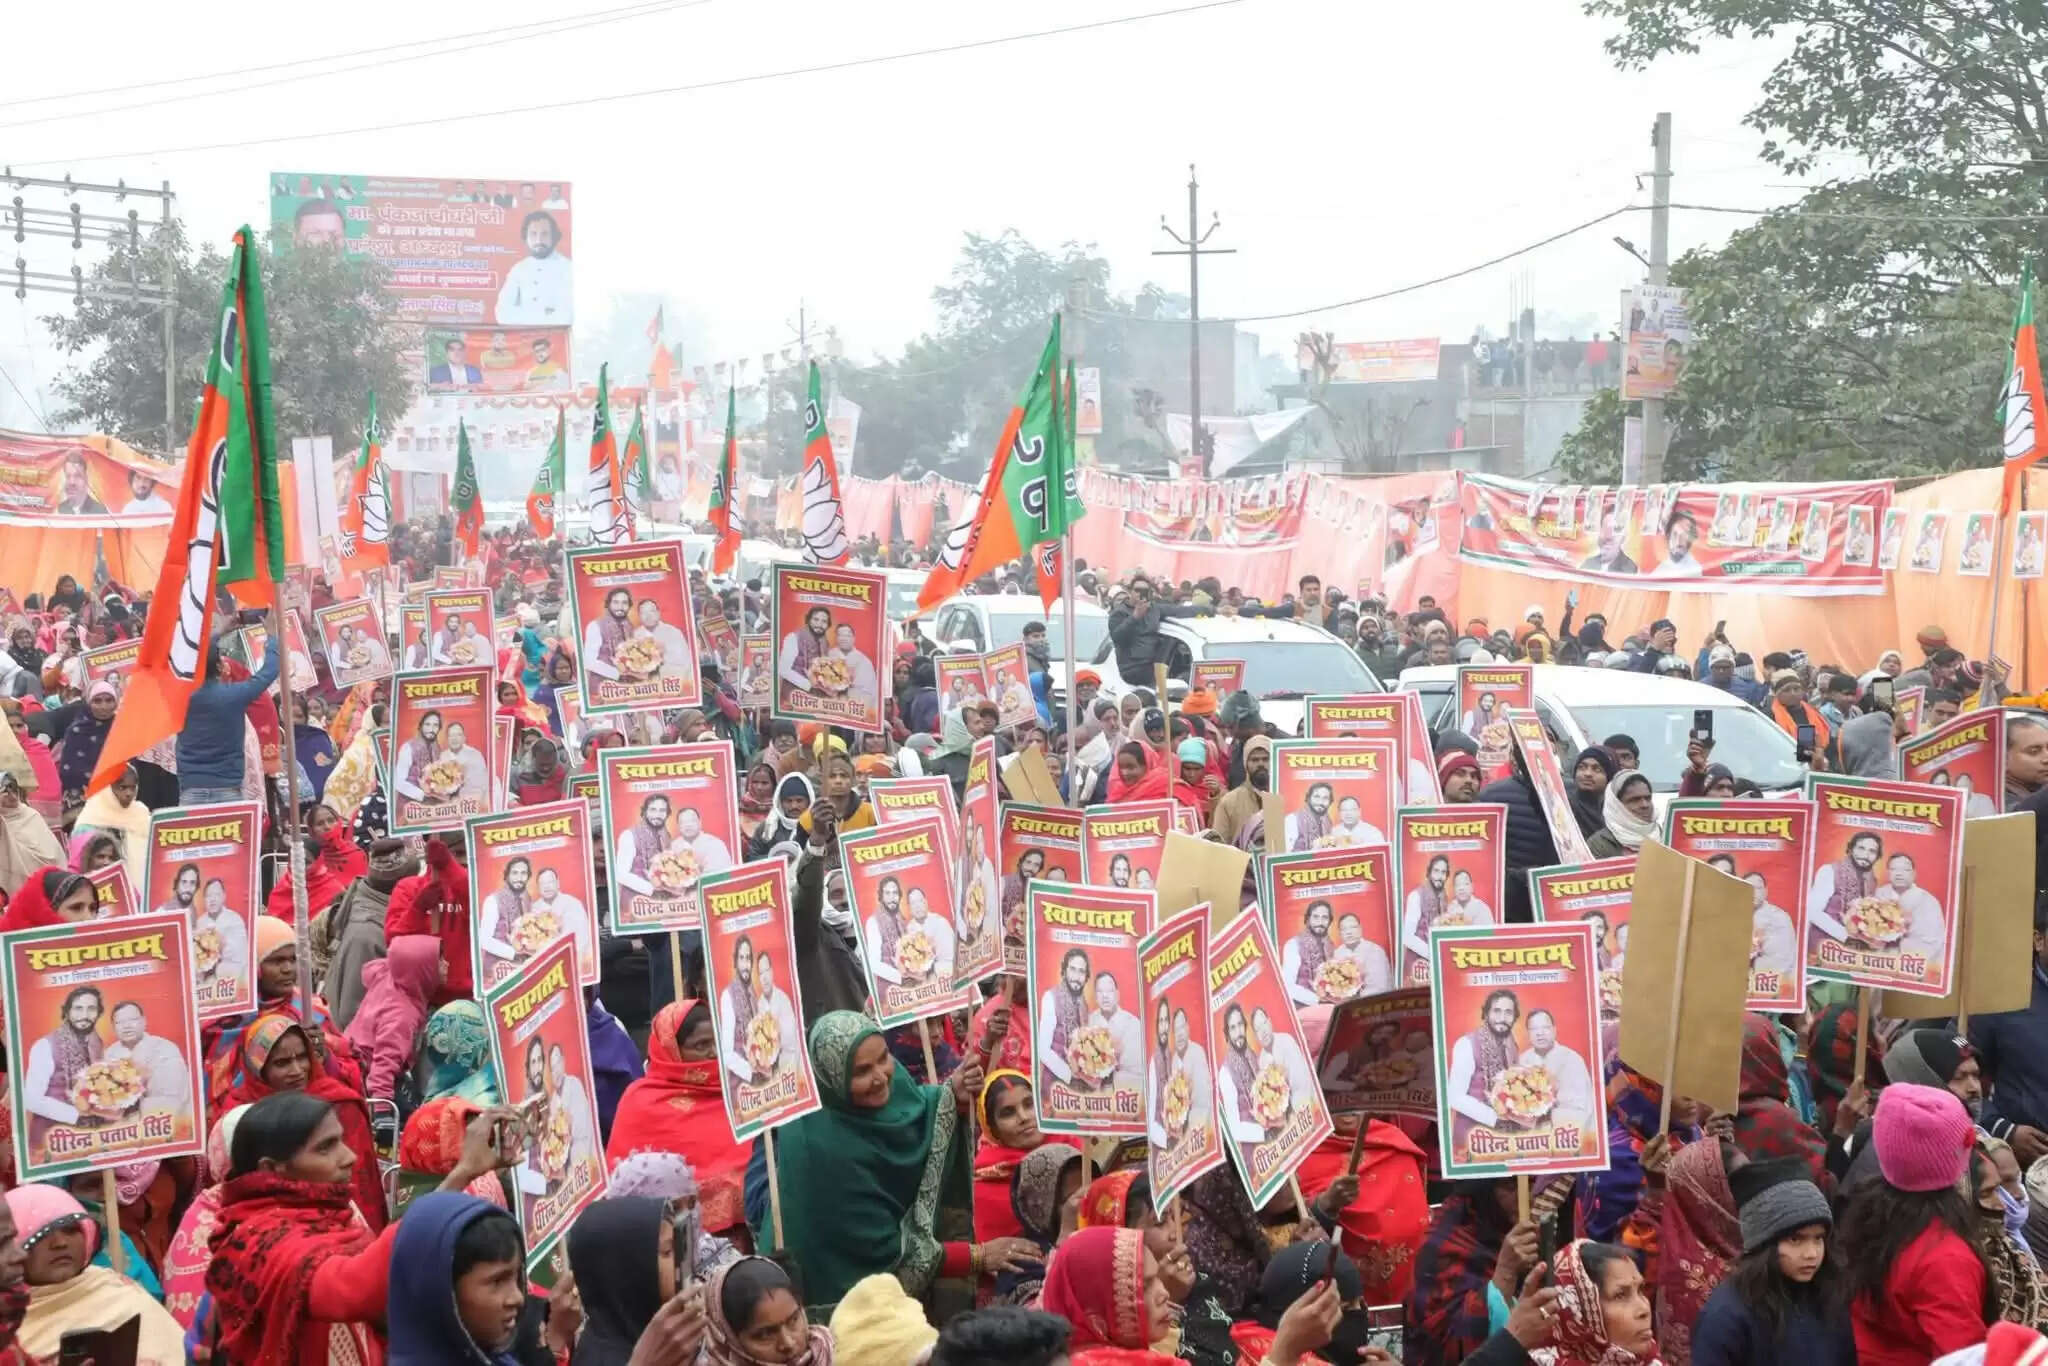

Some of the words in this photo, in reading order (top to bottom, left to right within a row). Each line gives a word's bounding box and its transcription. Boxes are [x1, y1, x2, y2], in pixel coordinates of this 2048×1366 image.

[582, 551, 671, 576] स्वागतम्
[787, 575, 870, 601] स्वागतम्
[403, 676, 479, 698] स्वागतम्
[633, 683, 660, 696] प्रताप
[662, 675, 680, 692] सिंह
[1317, 703, 1396, 721] स्वागतम्
[1910, 724, 1988, 767] स्वागतम्
[615, 757, 713, 781] स्वागतम्
[1287, 751, 1377, 767] स्वागतम्
[879, 790, 944, 808] स्वागतम्
[1827, 791, 1941, 825] स्वागतम्
[158, 819, 242, 847] स्वागतम्
[482, 815, 572, 845] स्वागतम्
[1089, 816, 1162, 837] स्वागतम्
[1409, 820, 1489, 838] स्वागतम्
[1683, 815, 1793, 840] स्वागतम्
[852, 833, 932, 864] स्वागतम्
[1281, 860, 1374, 887] स्वागतम्
[709, 879, 777, 916] स्वागतम्
[1042, 901, 1137, 934] स्वागतम्
[27, 932, 166, 971] स्वागतम्
[1450, 942, 1573, 969] स्वागतम्
[1821, 942, 1856, 965] धीरेन्द्र
[1861, 953, 1895, 972] प्रताप
[1900, 952, 1925, 974] सिंह
[48, 973, 68, 984] 317
[216, 976, 235, 997] सिंह
[1755, 971, 1778, 991] सिंह
[500, 959, 569, 1028] स्वागतम्
[1052, 1088, 1080, 1109] धीरेन्द्र
[1084, 1095, 1112, 1114] प्रताप
[1117, 1089, 1137, 1112] सिंह
[48, 1126, 93, 1153] धीरेन्द्र
[99, 1124, 139, 1147] प्रताप
[144, 1111, 172, 1137] सिंह
[1280, 1129, 1298, 1151] प्रताप
[1297, 1104, 1313, 1132] सिंह
[1470, 1130, 1509, 1154] धीरेन्द्र
[1515, 1134, 1551, 1153] प्रताप
[1554, 1124, 1579, 1148] सिंह
